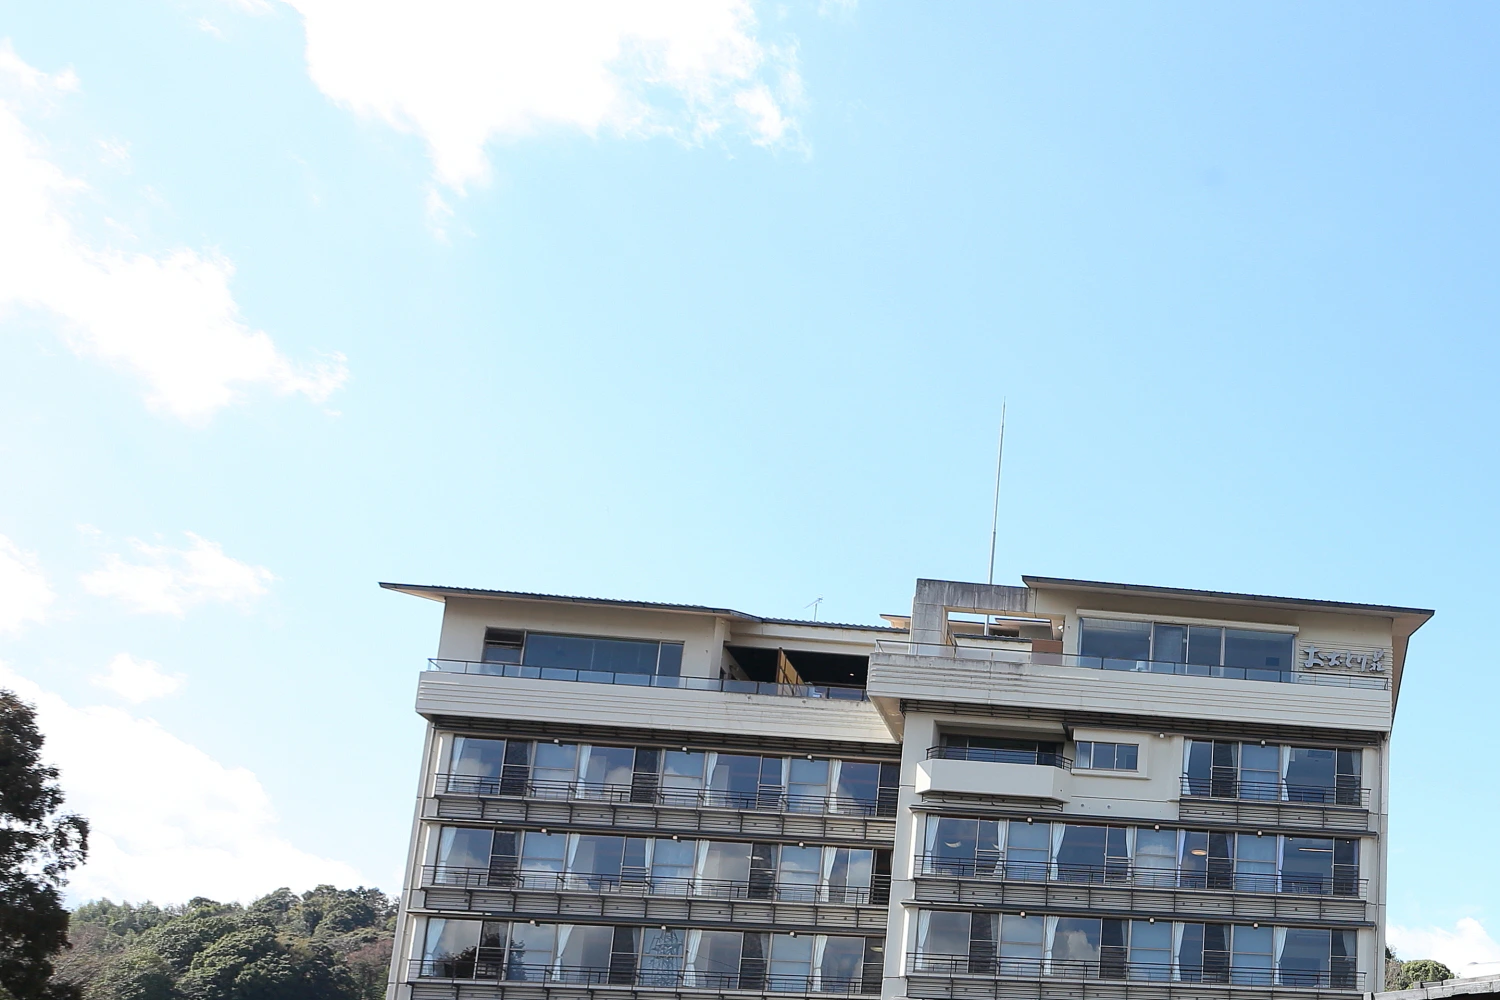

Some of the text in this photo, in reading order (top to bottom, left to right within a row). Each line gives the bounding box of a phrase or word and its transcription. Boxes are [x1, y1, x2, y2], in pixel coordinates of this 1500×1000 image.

[1303, 645, 1386, 672] おおとり荘
